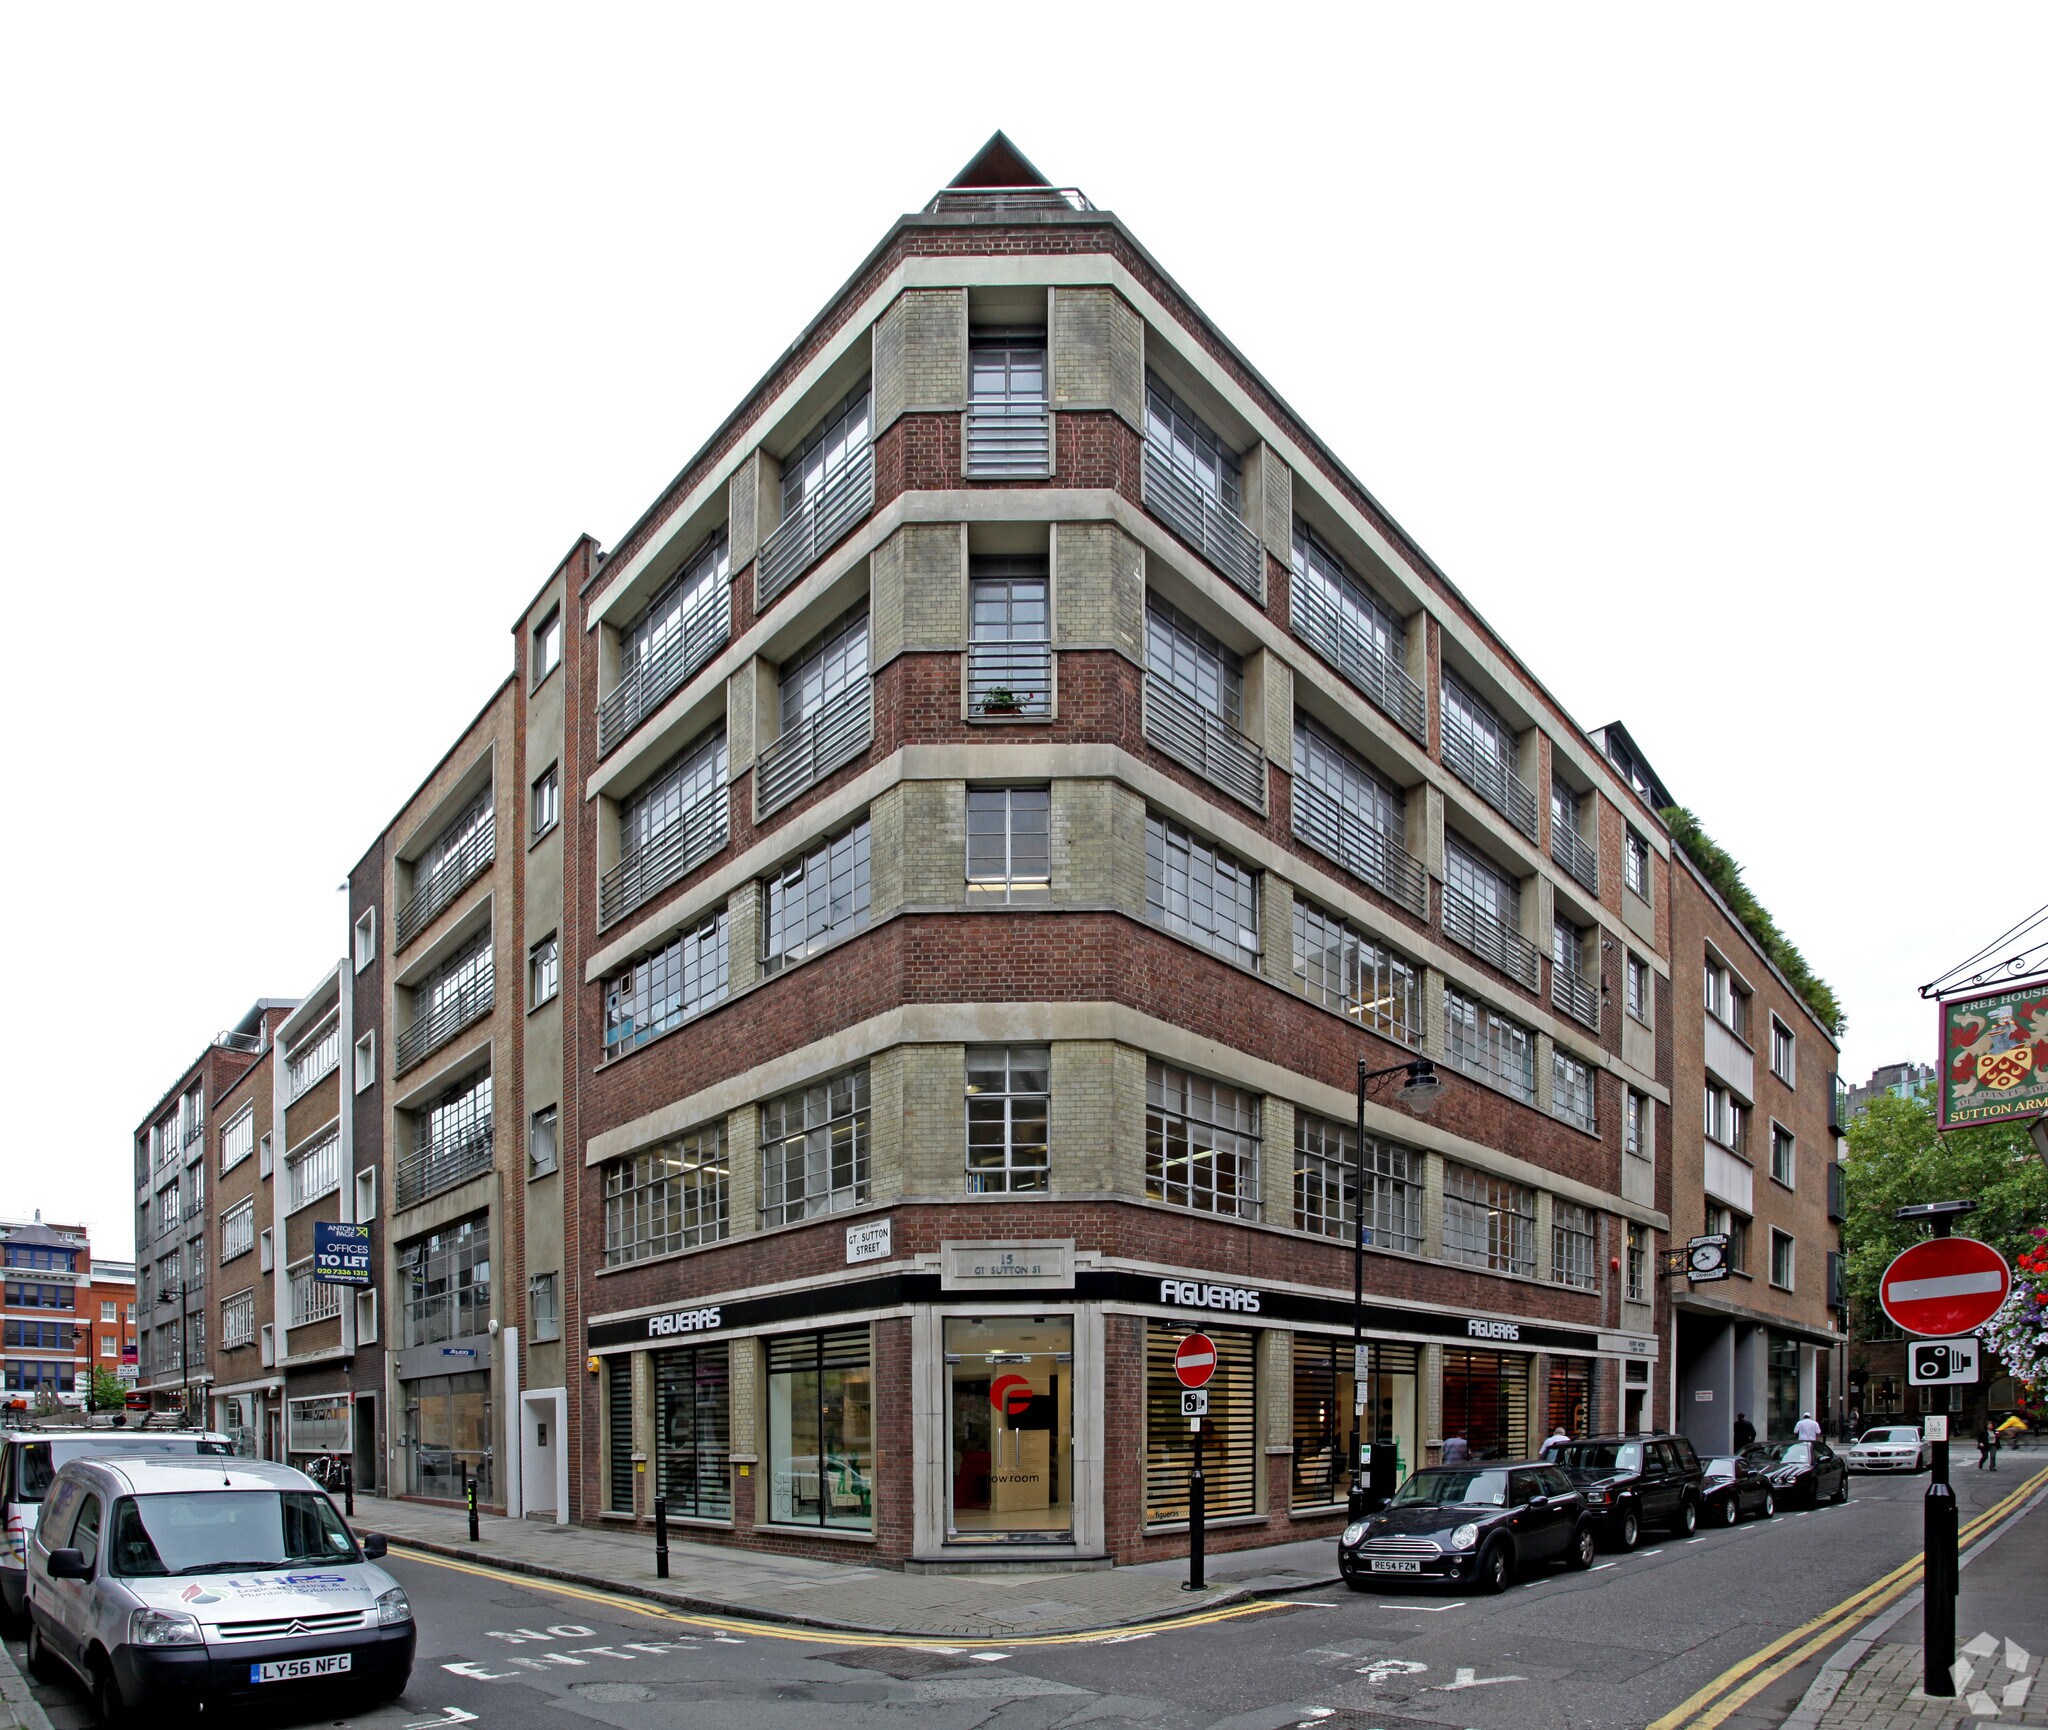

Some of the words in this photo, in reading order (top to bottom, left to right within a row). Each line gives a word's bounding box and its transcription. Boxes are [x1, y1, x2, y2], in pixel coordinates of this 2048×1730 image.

[1961, 998, 1997, 1012] FREE
[2000, 987, 2048, 1004] HOUSE
[1950, 1103, 2012, 1122] SUTTON
[848, 1235, 859, 1245] GT.
[861, 1228, 888, 1242] SUTTON
[327, 1243, 368, 1253] OFFICES
[856, 1242, 880, 1255] STREET
[319, 1254, 340, 1266] TO
[344, 1256, 368, 1267] LET
[1001, 1254, 1013, 1265] 15
[990, 1265, 1028, 1275] SUTTON
[1160, 1279, 1260, 1313] FIGUERAS
[648, 1306, 721, 1337] FIGUERAS
[1467, 1319, 1520, 1341] FIGUERAS
[1009, 1474, 1040, 1483] room
[1374, 1561, 1397, 1570] RE54
[228, 1574, 347, 1588] LHPS
[240, 1590, 294, 1598] Plumbing
[484, 1625, 597, 1644] NO
[263, 1660, 311, 1680] LY56
[316, 1656, 349, 1673] NFC
